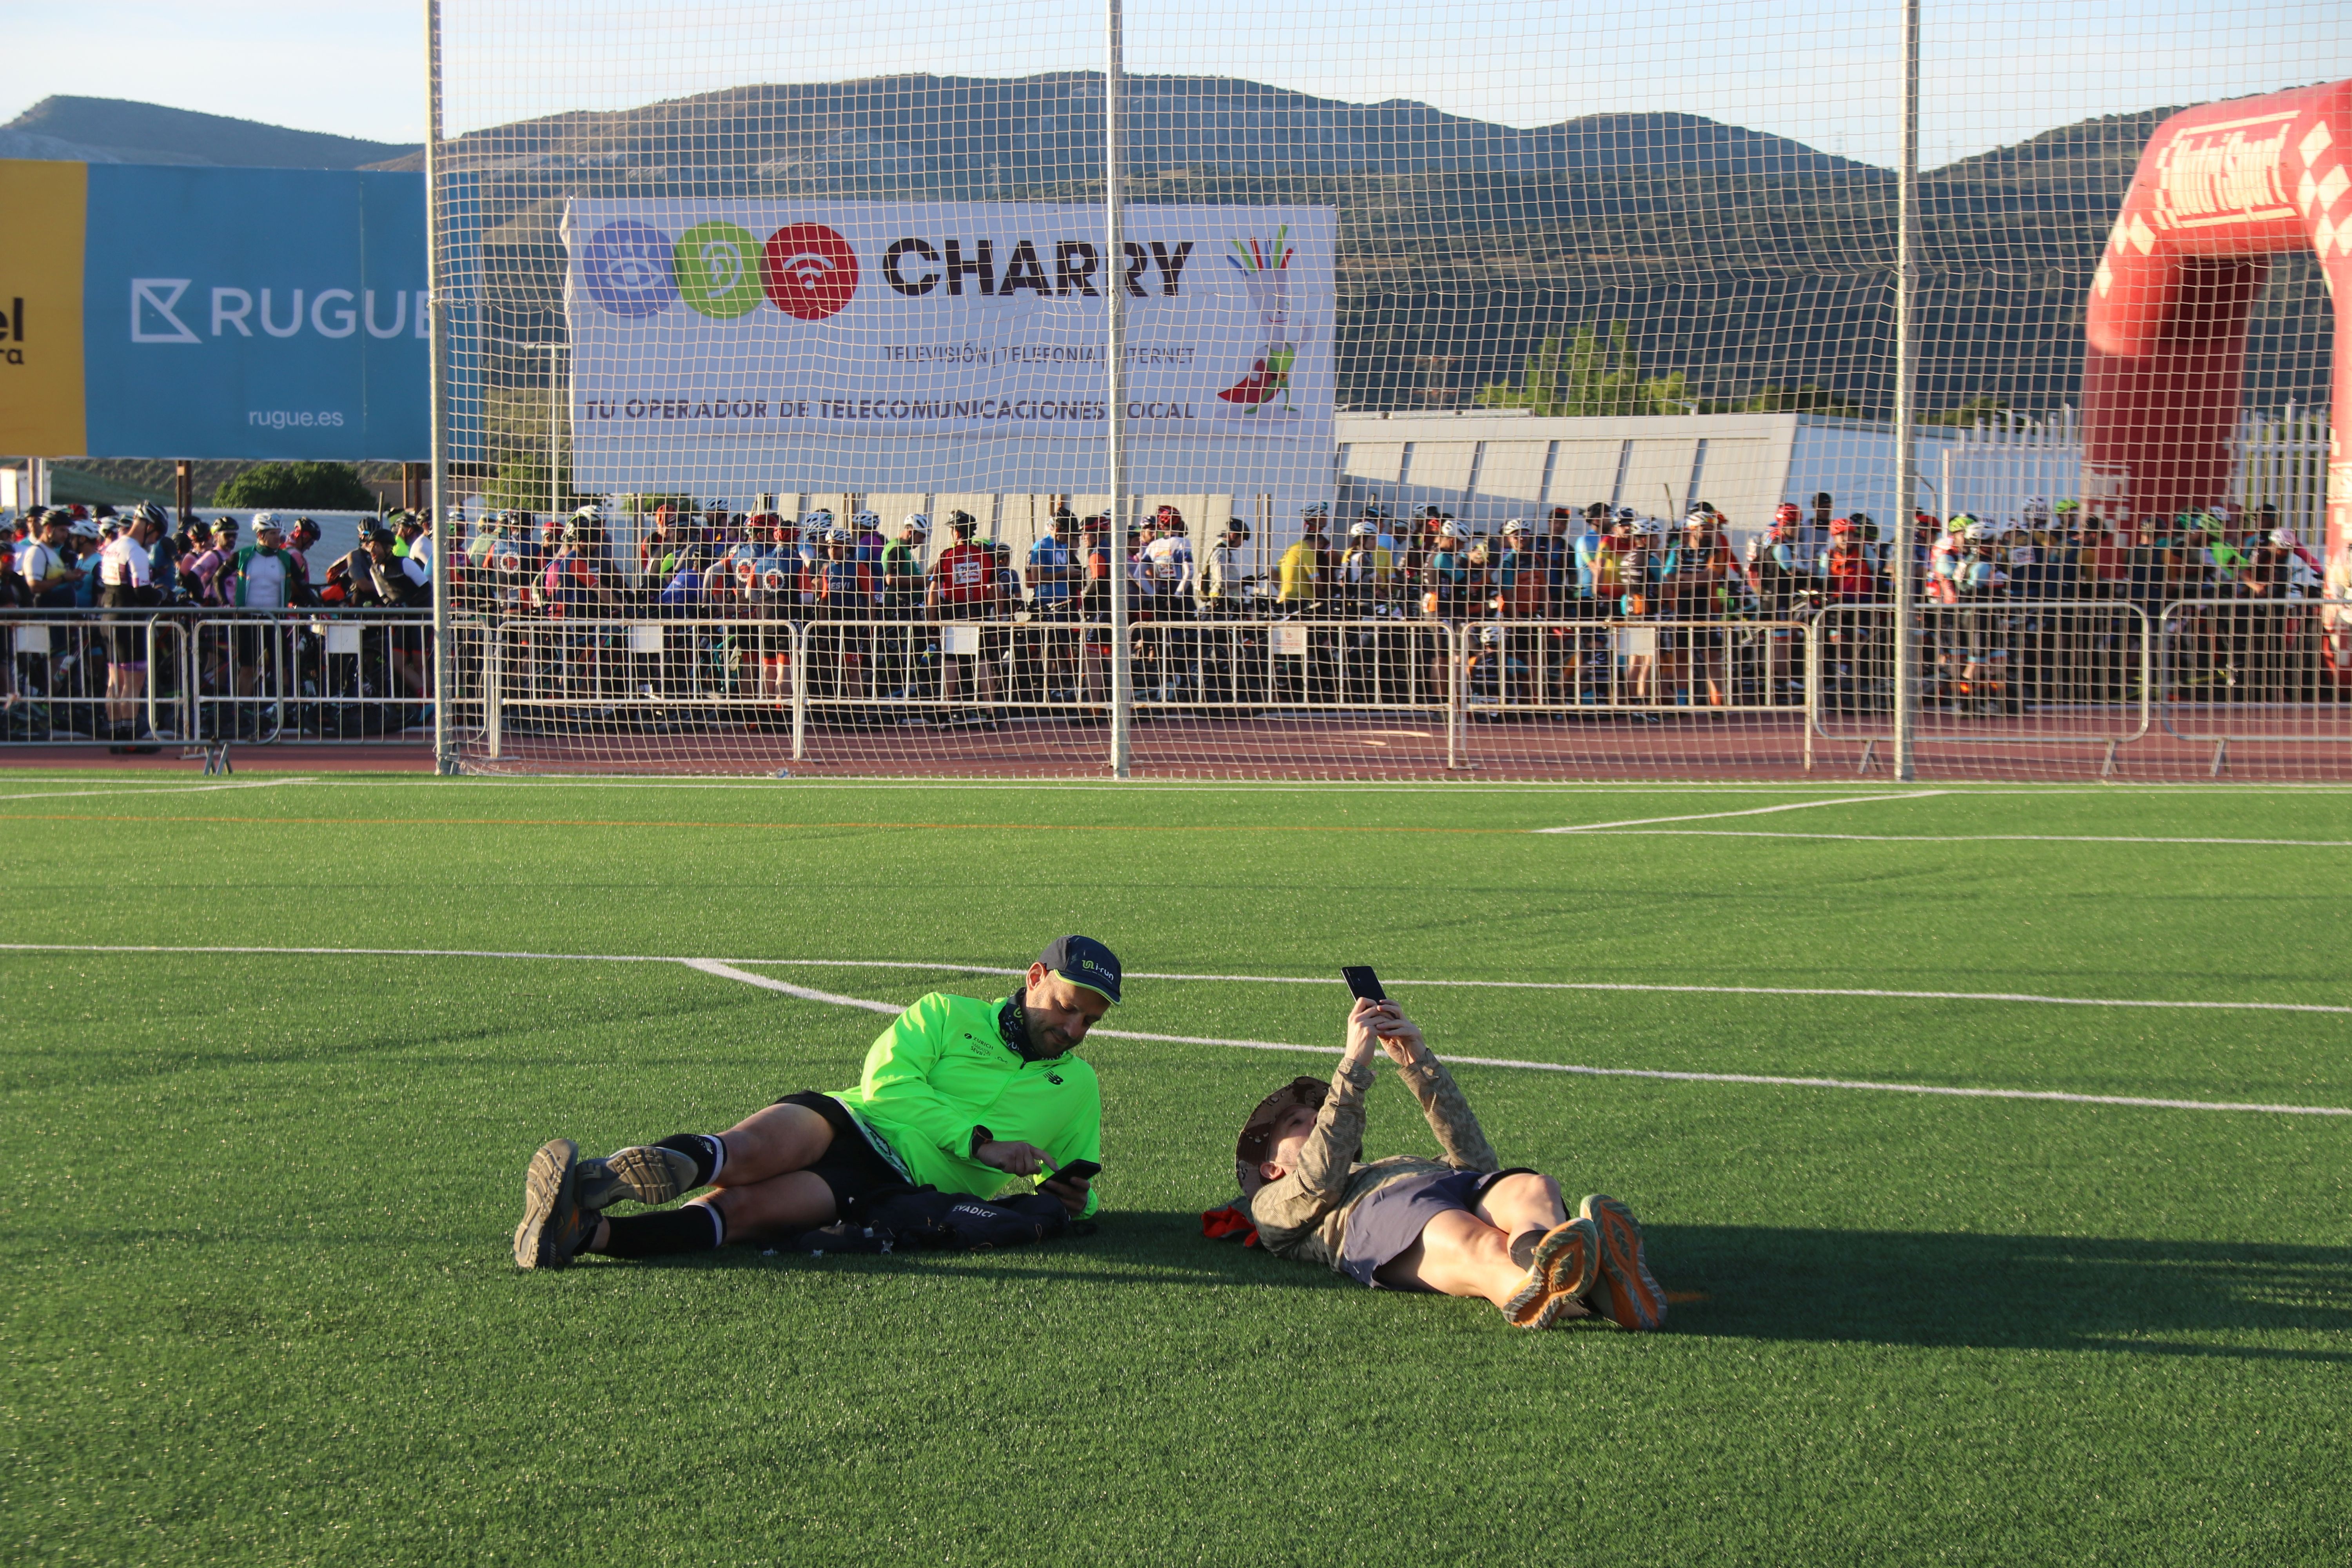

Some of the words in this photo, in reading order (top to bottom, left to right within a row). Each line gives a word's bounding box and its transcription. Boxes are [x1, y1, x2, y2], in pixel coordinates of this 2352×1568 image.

[882, 238, 1194, 297] CHARRY
[212, 287, 451, 339] RUGUE
[884, 342, 987, 363] TELEVISIÓN
[1001, 343, 1096, 363] TELEFONÍA
[1125, 348, 1195, 363] TERNET
[249, 410, 344, 429] rugue.es
[585, 399, 615, 420] TU
[626, 399, 768, 419] OPERADOR
[780, 400, 809, 417] DE
[819, 400, 1105, 420] TELECOMUNICACIONES
[1127, 401, 1194, 419] OCAL
[1095, 963, 1114, 981] i-run
[973, 1036, 994, 1050] ZURICH
[952, 1205, 997, 1218] EVADICT
